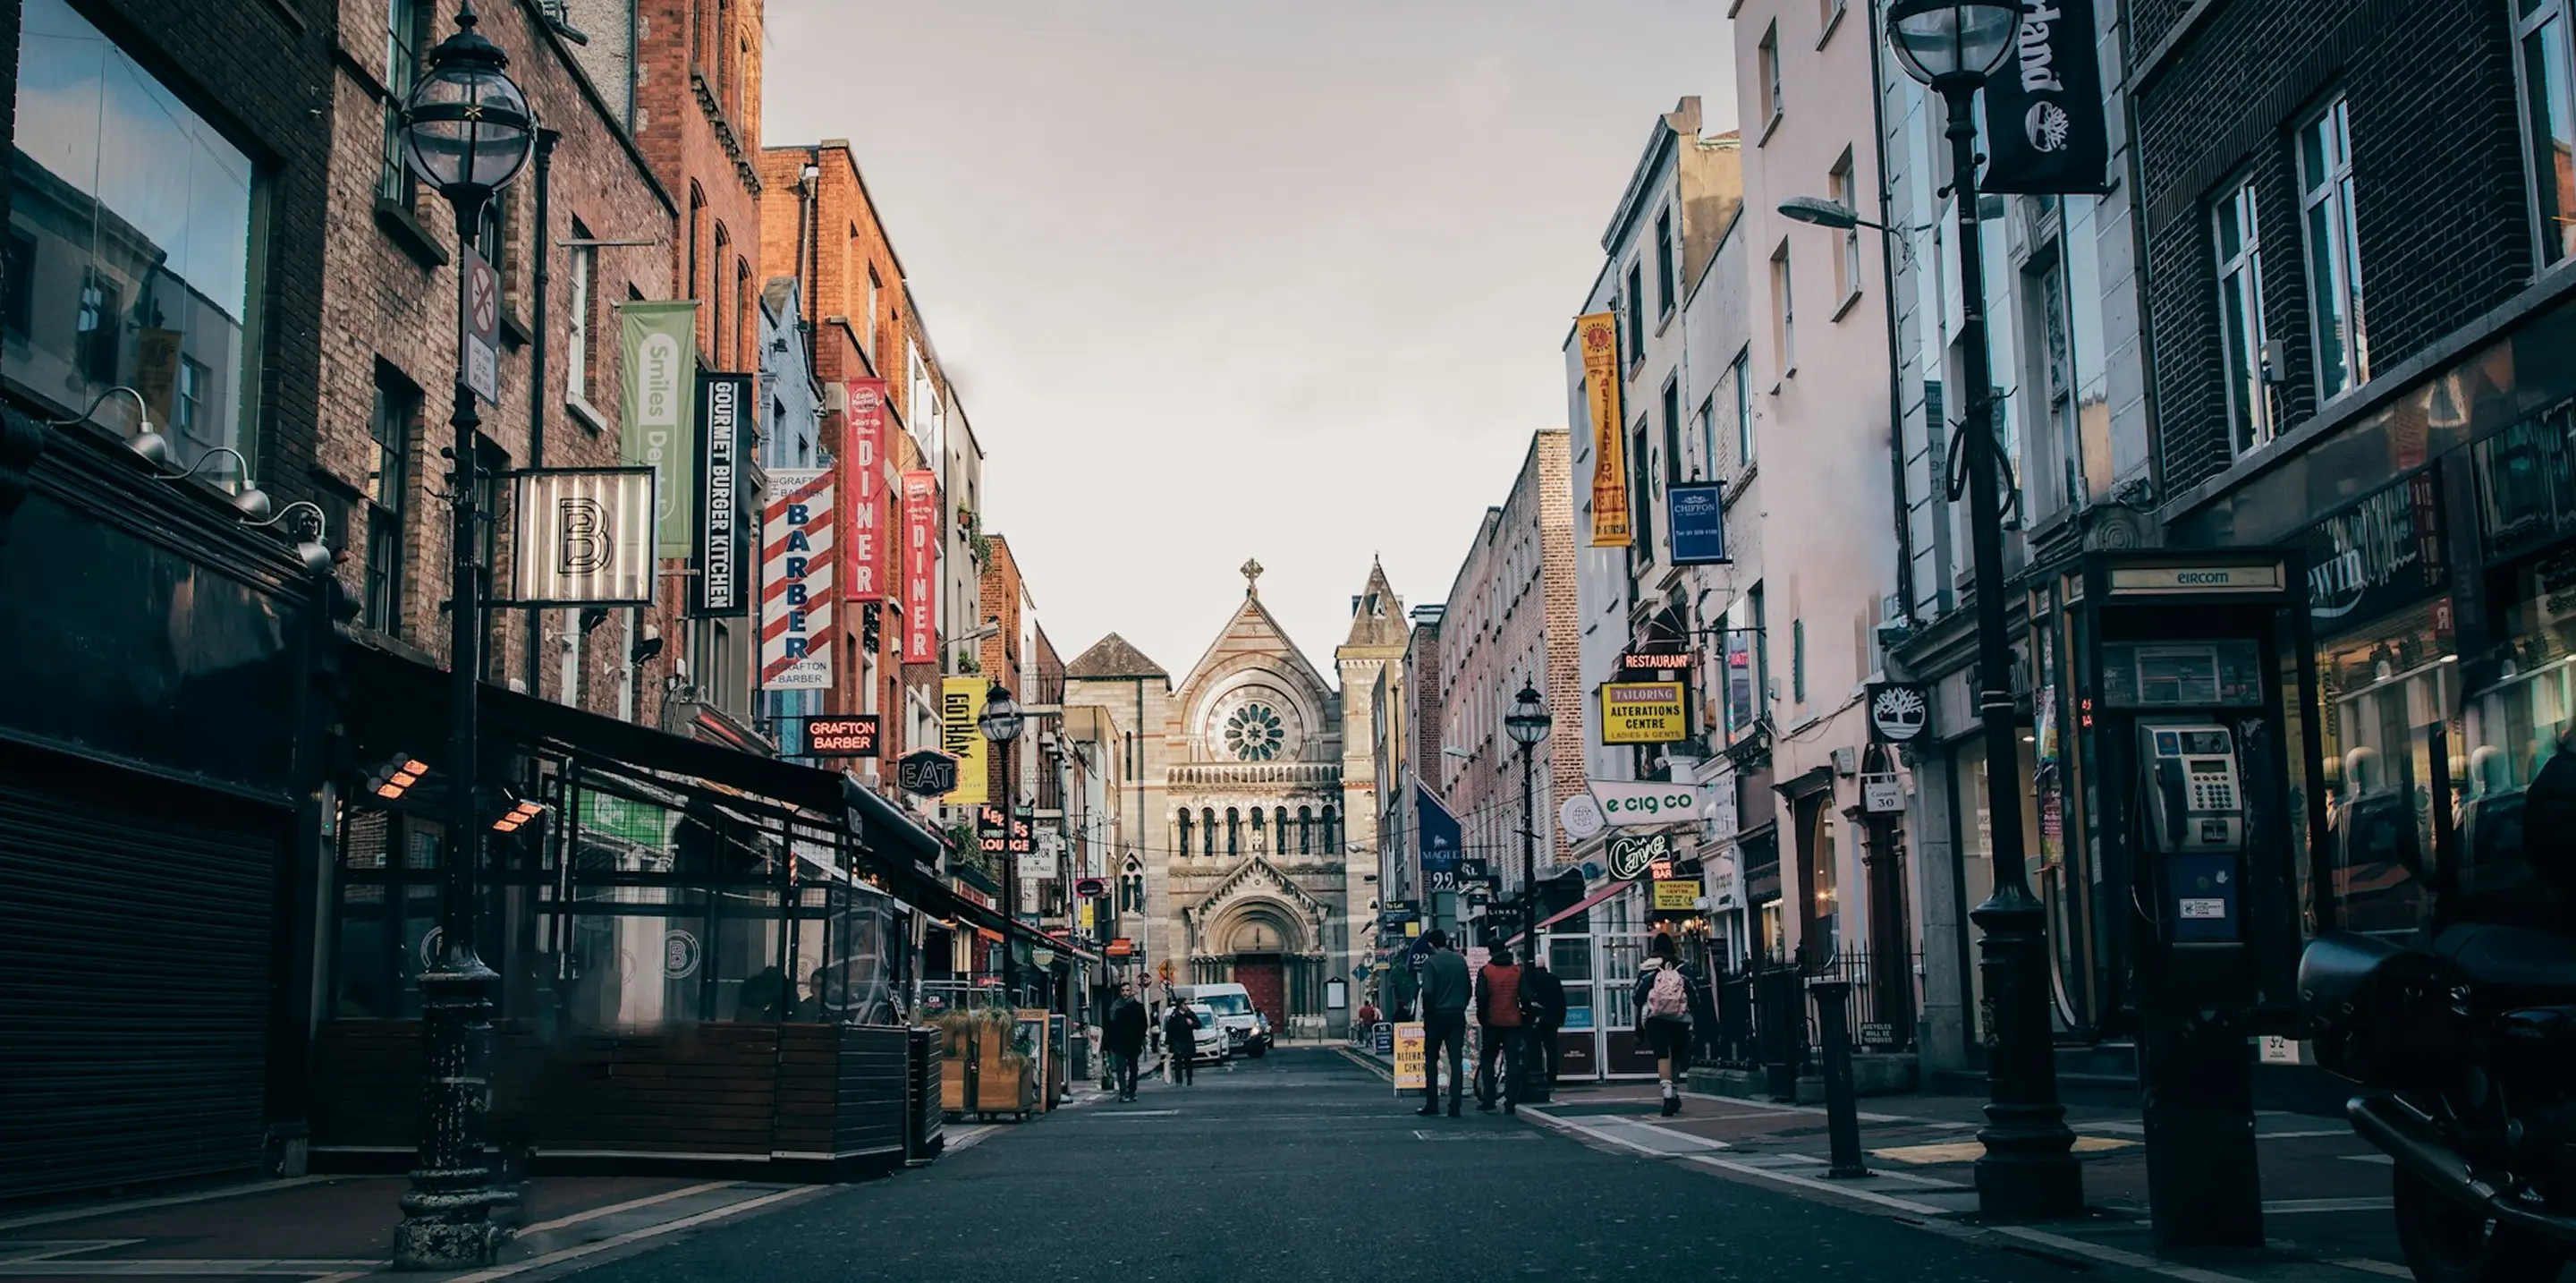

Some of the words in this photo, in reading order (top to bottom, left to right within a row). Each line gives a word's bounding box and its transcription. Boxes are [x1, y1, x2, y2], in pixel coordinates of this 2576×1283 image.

[2017, 0, 2063, 93] rland
[649, 345, 670, 418] Smiles
[713, 381, 733, 463] GOURMET
[780, 476, 828, 486] GRAFTON
[711, 465, 730, 531] BURGER
[780, 489, 825, 497] BARBER
[1674, 503, 1716, 513] CHIFFON
[857, 439, 873, 593] DINER
[558, 497, 612, 574] B
[709, 534, 729, 608] KITCHEN
[2177, 571, 2229, 584] eircom
[785, 503, 810, 660] BARBER
[912, 524, 927, 656] DINER
[775, 662, 827, 671] GRAFTON
[778, 675, 822, 684] BARBER
[1615, 688, 1673, 701] TAILORING
[1611, 705, 1680, 717] ALTERATIONS
[809, 721, 876, 735] GRAFTON
[945, 693, 979, 759] GOTHAM
[1626, 718, 1665, 729] CENTRE
[1612, 731, 1641, 740] LADIES
[1652, 730, 1682, 739] GENTS
[814, 736, 870, 749] BARBER
[902, 760, 953, 788] EAT
[1606, 799, 1619, 812] e
[1624, 795, 1658, 814] cig
[1664, 794, 1692, 808] co
[1877, 799, 1894, 807] 30
[980, 838, 1030, 852] LOUGE
[1422, 851, 1460, 860] MAGEE
[1433, 871, 1455, 889] 22
[1653, 869, 1672, 879] BAR
[1412, 953, 1428, 964] 22
